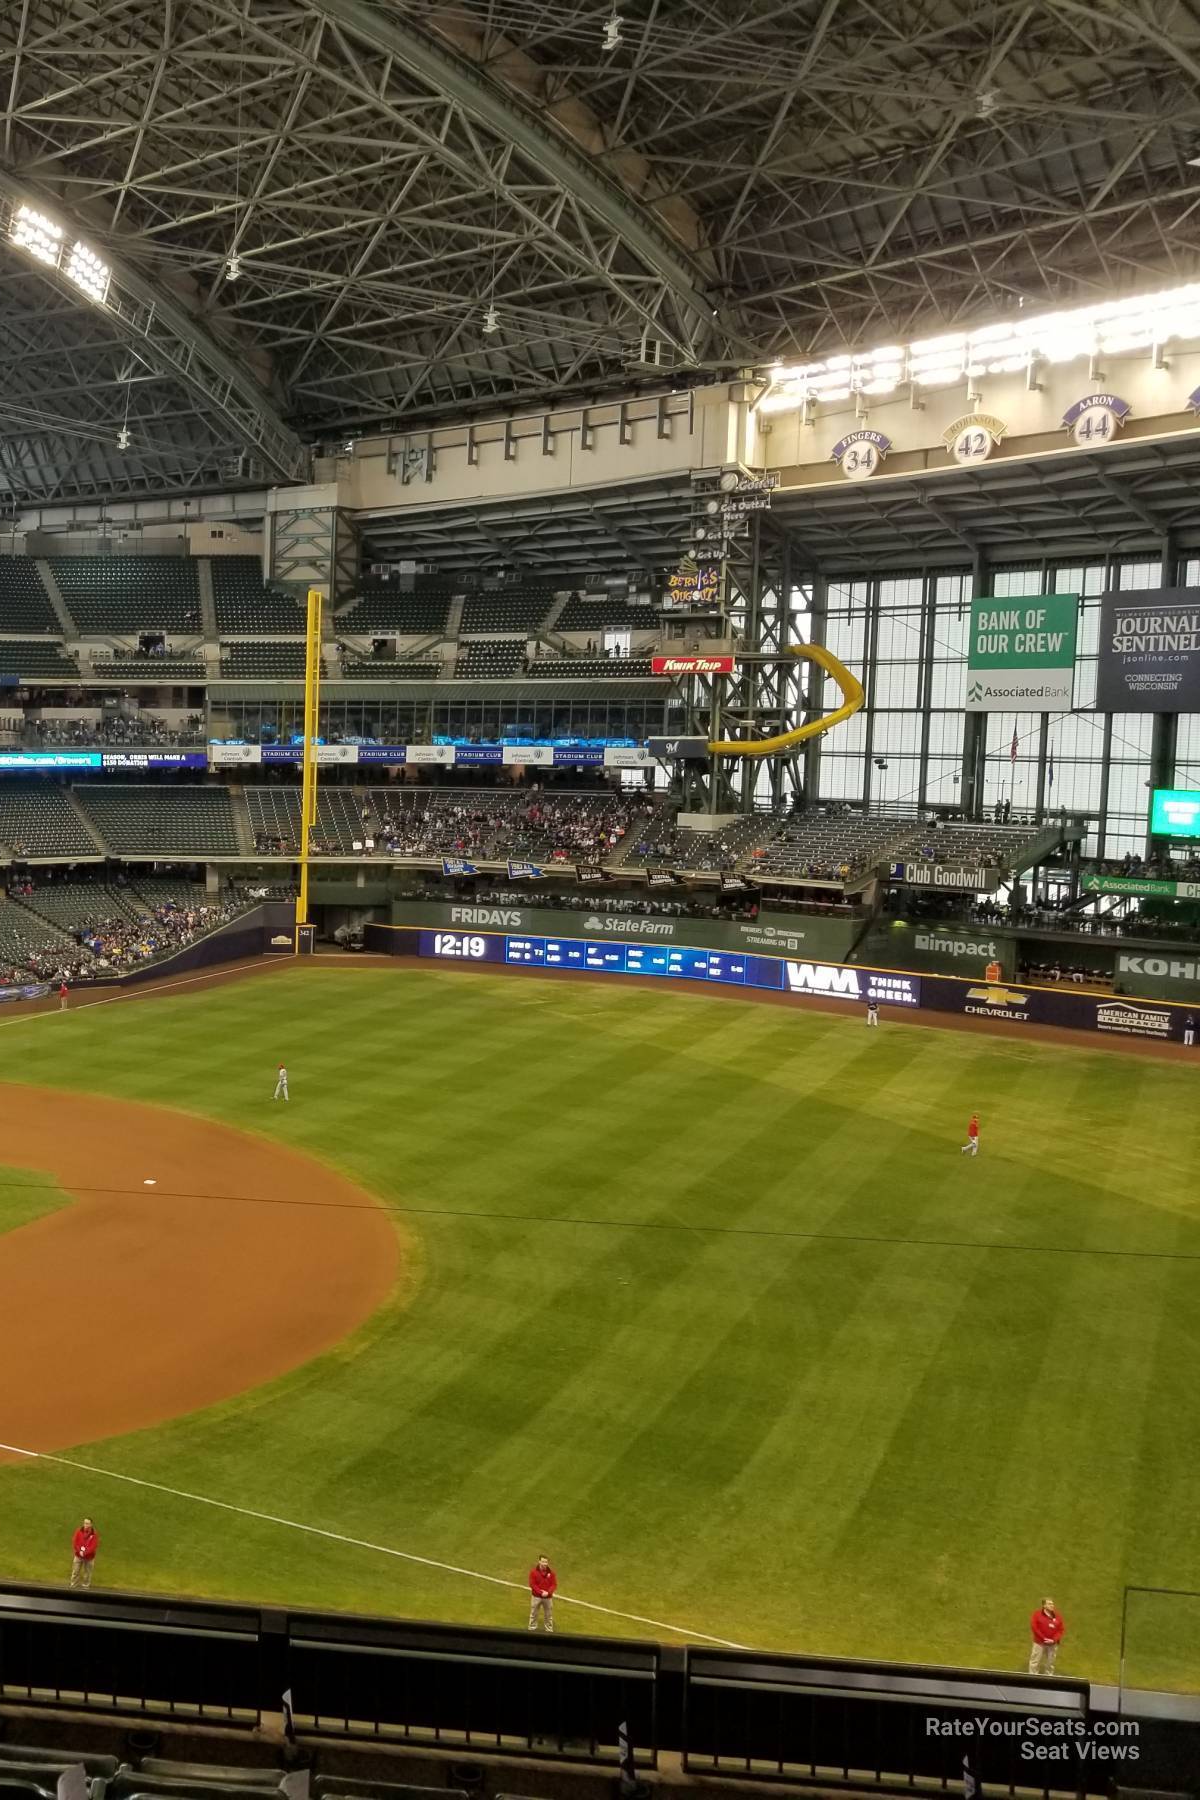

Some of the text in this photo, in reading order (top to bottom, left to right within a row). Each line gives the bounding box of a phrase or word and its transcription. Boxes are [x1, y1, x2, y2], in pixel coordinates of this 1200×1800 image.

[1080, 396, 1114, 412] AARON
[1079, 414, 1108, 438] 44
[841, 431, 882, 447] FINGERS
[958, 432, 987, 457] 42
[846, 448, 873, 472] 34
[978, 608, 1046, 631] BANK OF
[1112, 615, 1200, 637] JOURNAL
[976, 632, 1064, 654] OUR CREW
[1111, 633, 1200, 653] SENTINEL
[1122, 653, 1189, 665] jsonline.com
[1124, 673, 1183, 682] CONNECTING
[1128, 682, 1179, 690] WISCONSIN
[906, 863, 931, 884] Club
[934, 865, 986, 889] Goodwill
[451, 907, 522, 926] FRIDAYS
[434, 934, 485, 957] 12:19
[928, 933, 996, 958] impact
[1120, 956, 1200, 980] KOH
[870, 976, 912, 990] THINK
[964, 1005, 1030, 1021] CHEVROLET
[1098, 1008, 1170, 1022] AMERICAN FAMILY
[1102, 1016, 1164, 1028] INSURANCE
